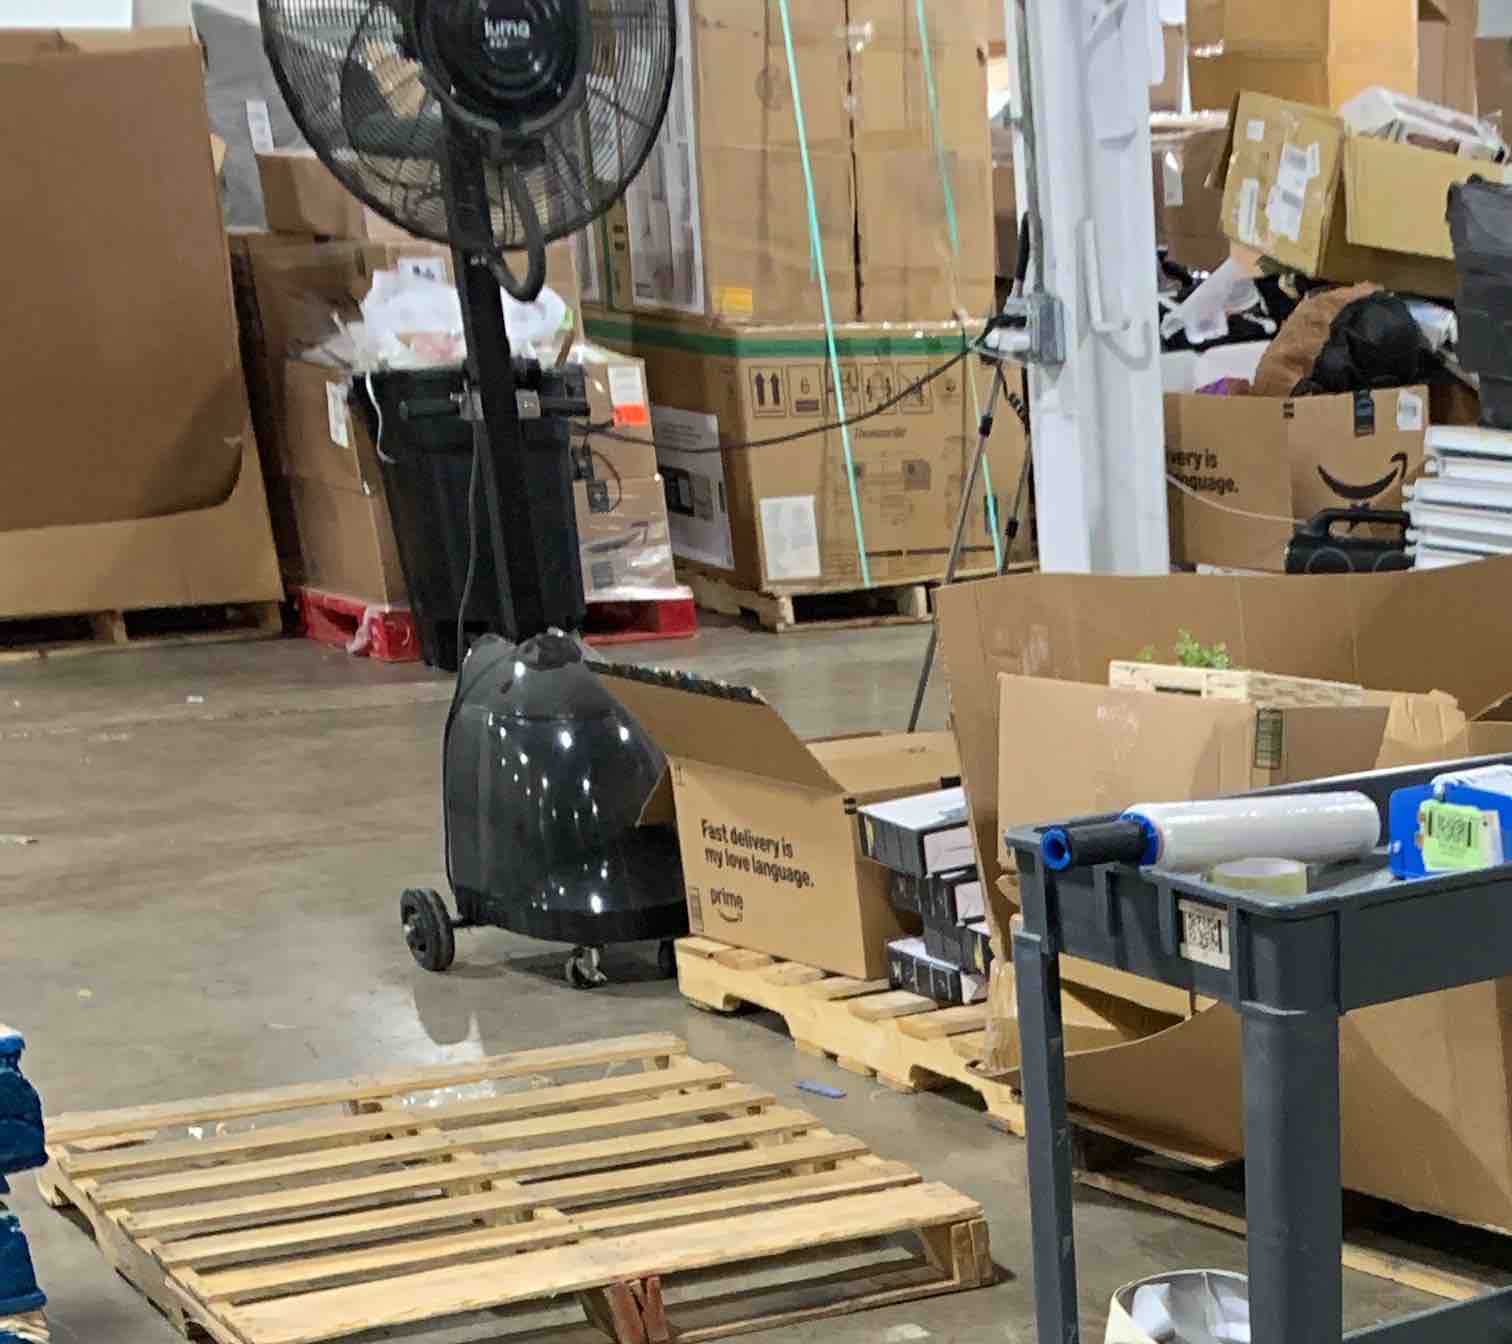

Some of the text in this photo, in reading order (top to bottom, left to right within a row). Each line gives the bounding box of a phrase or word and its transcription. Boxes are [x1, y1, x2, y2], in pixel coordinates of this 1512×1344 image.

[1204, 448, 1218, 468] is
[701, 818, 794, 859] Fast delivery is
[704, 847, 815, 889] my love language.
[710, 887, 744, 911] prime
